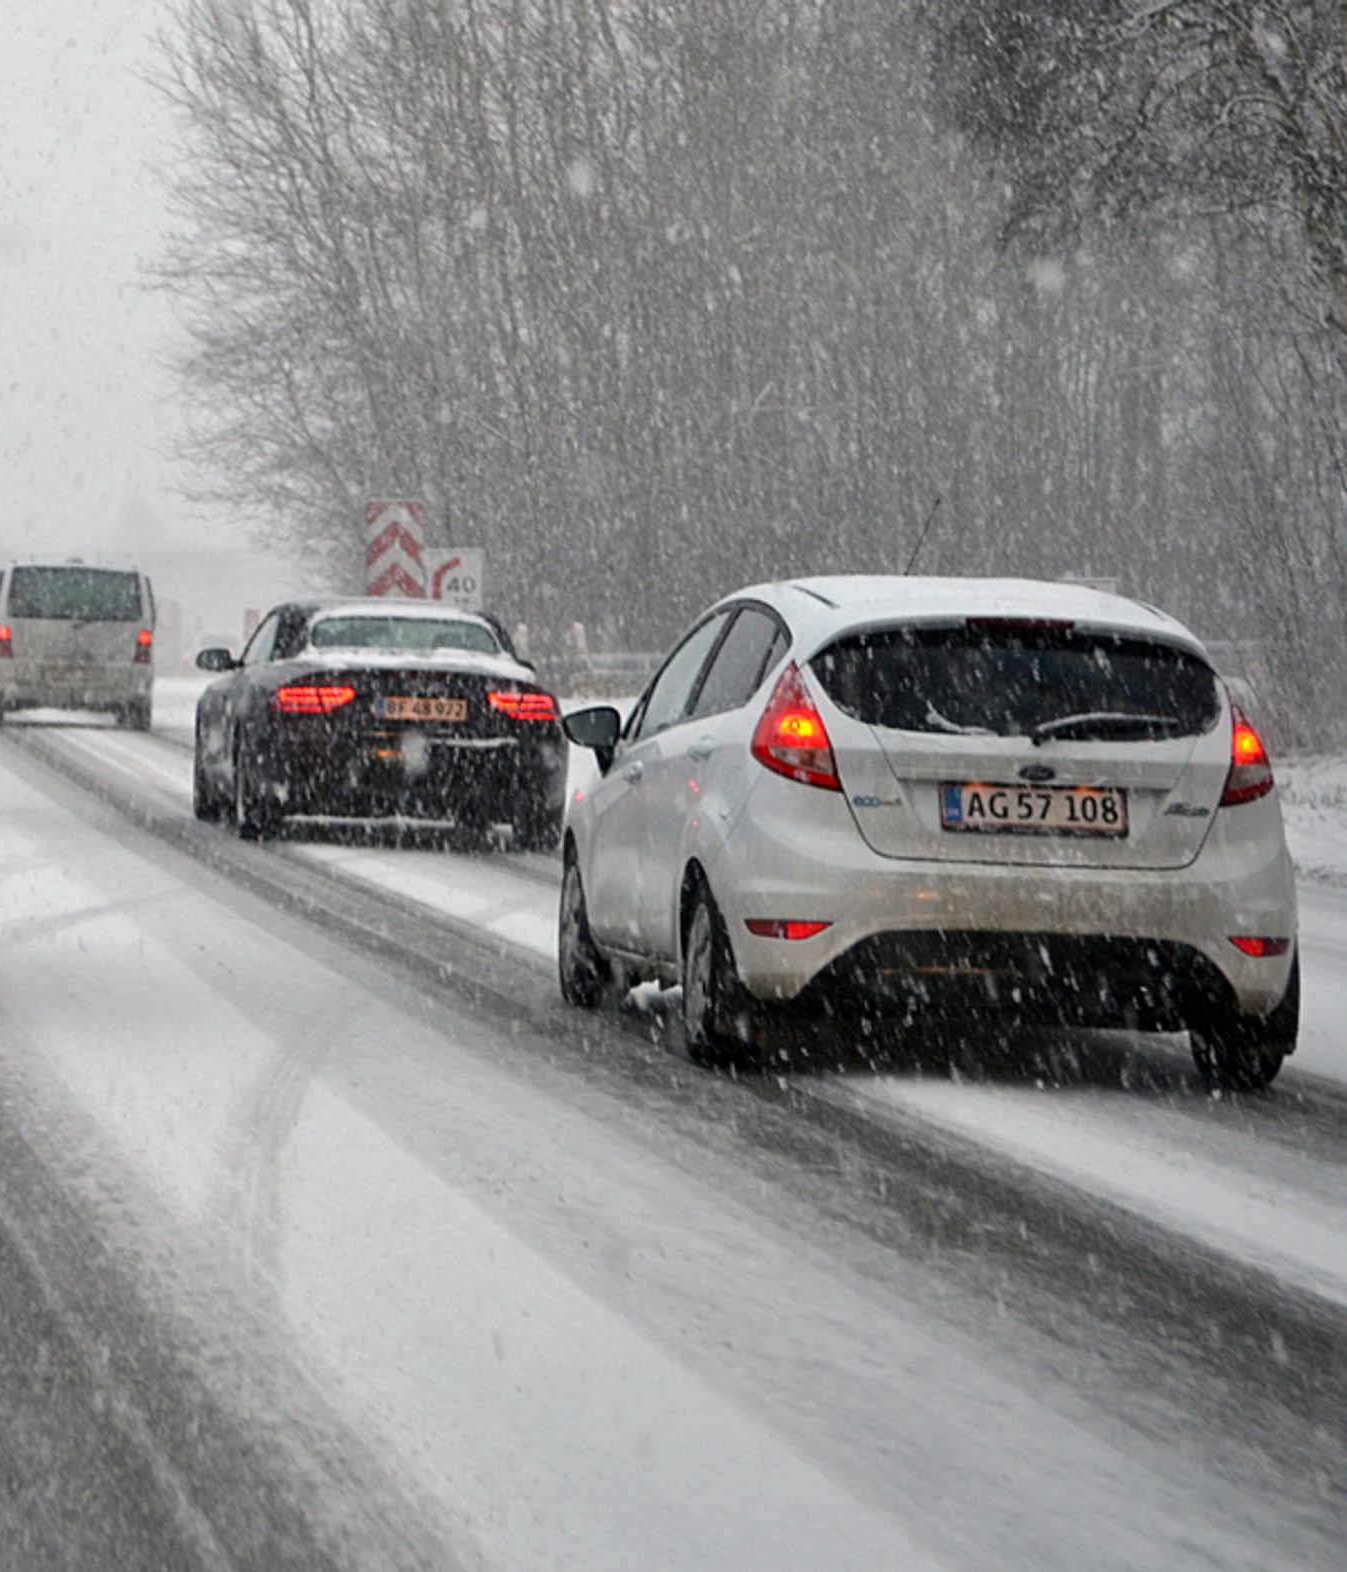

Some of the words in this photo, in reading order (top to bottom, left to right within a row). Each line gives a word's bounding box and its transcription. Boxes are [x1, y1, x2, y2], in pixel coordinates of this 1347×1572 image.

[447, 576, 476, 594] 40
[967, 793, 1009, 819] AG
[1016, 793, 1052, 820] 57
[1066, 796, 1118, 824] 108
